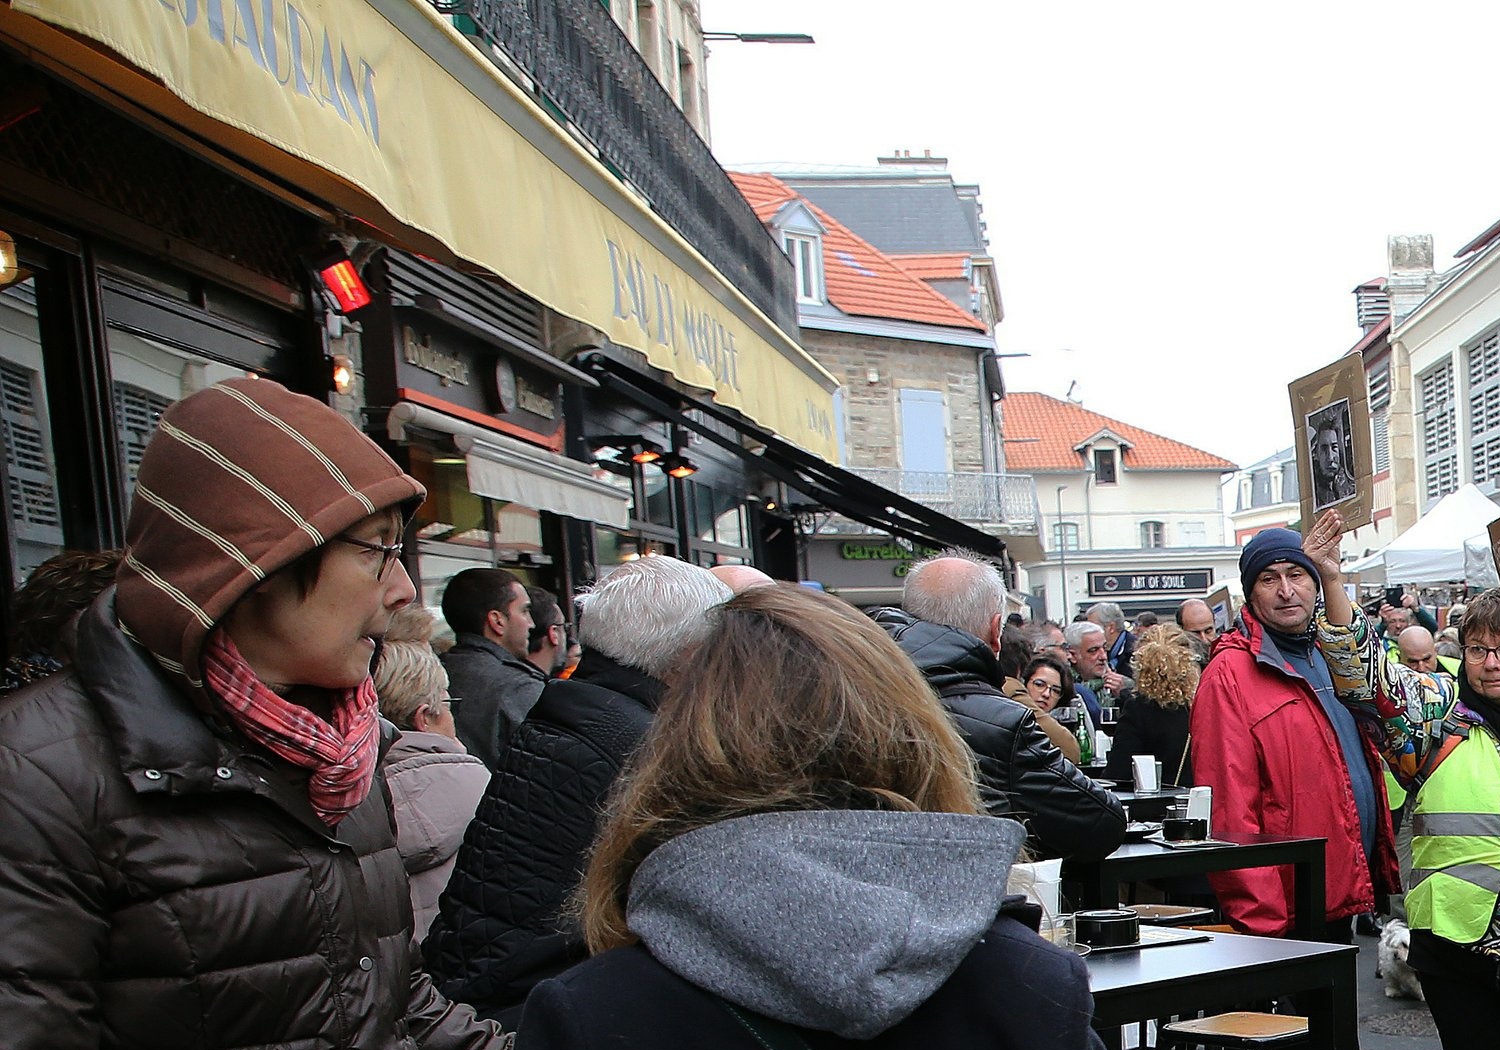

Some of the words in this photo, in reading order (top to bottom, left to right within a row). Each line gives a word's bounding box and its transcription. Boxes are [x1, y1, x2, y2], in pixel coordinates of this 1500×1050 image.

[156, 0, 379, 148] AURANT
[1131, 576, 1145, 589] ART
[1148, 576, 1160, 588] OF
[1162, 575, 1186, 588] SOULE
